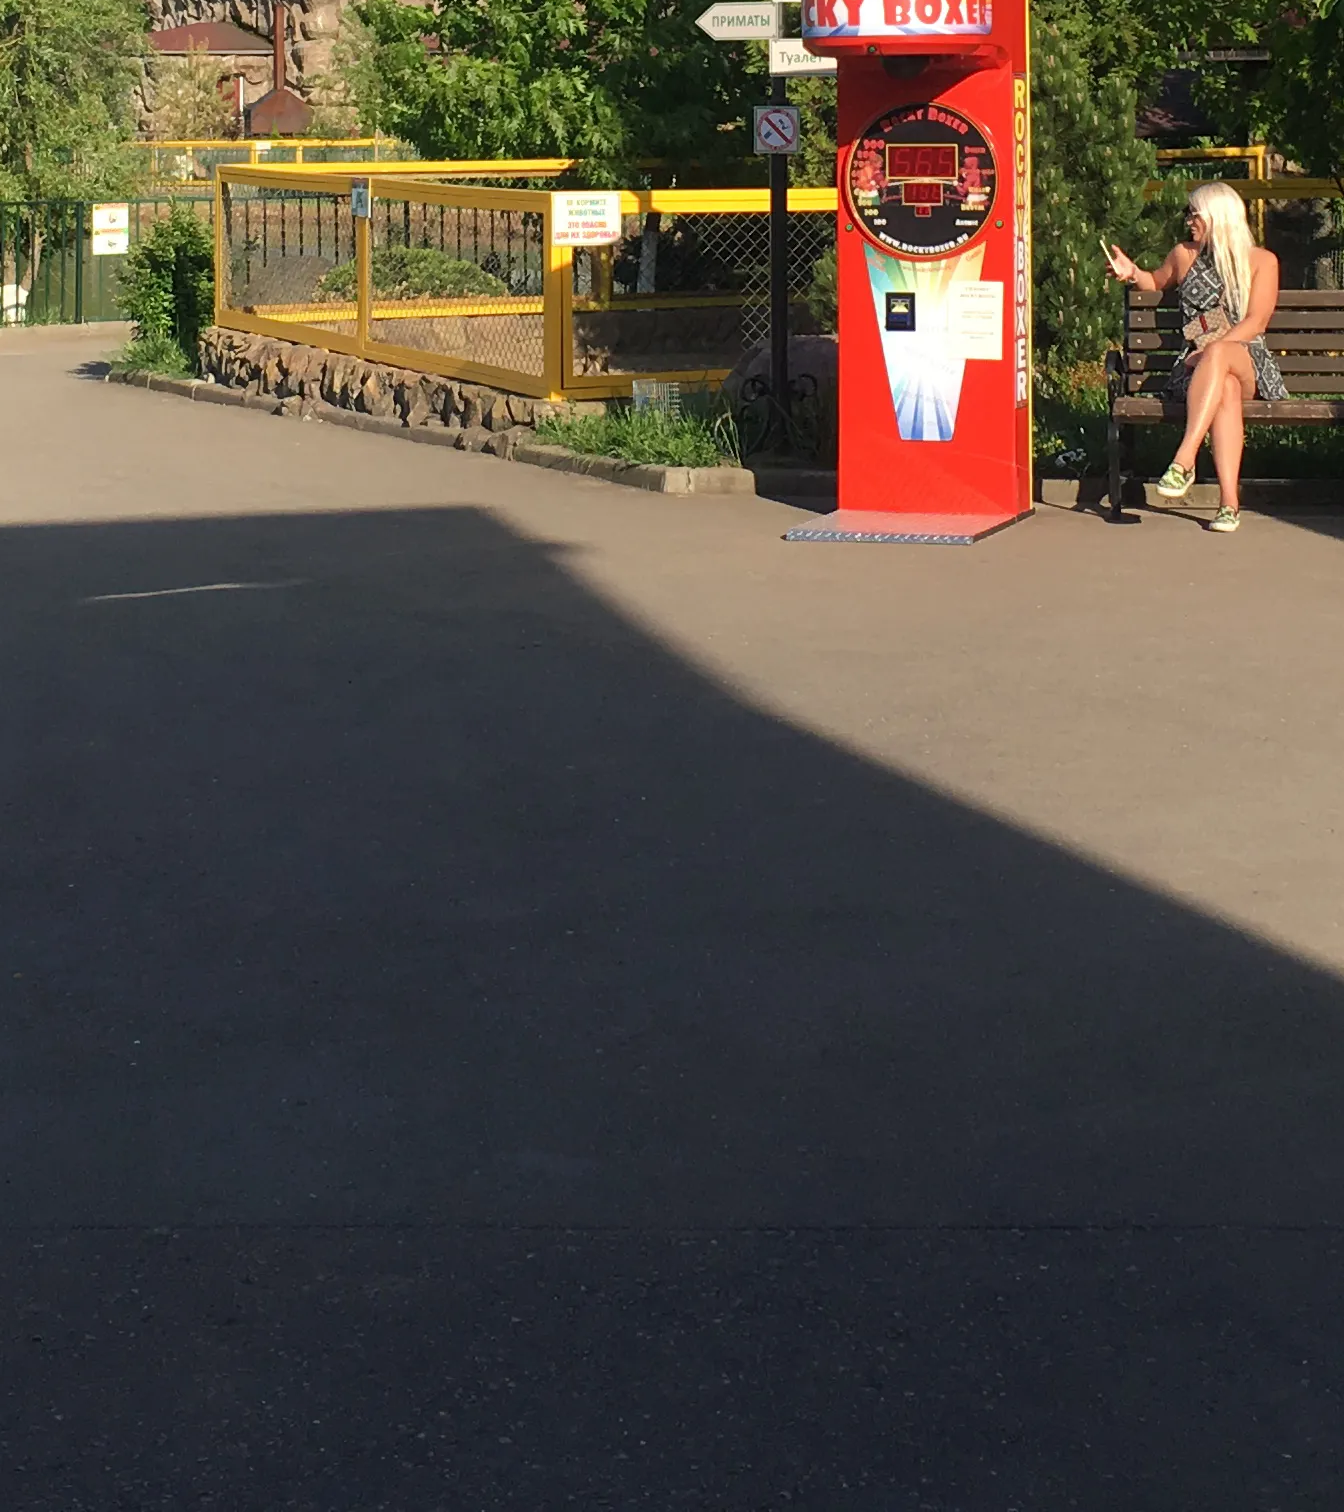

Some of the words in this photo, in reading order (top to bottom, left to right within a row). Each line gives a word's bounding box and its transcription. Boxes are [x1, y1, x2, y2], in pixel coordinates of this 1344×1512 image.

[712, 14, 770, 28] ПРИМАТЫ
[1014, 78, 1026, 238] ROCKY
[1015, 239, 1027, 402] BOXER
